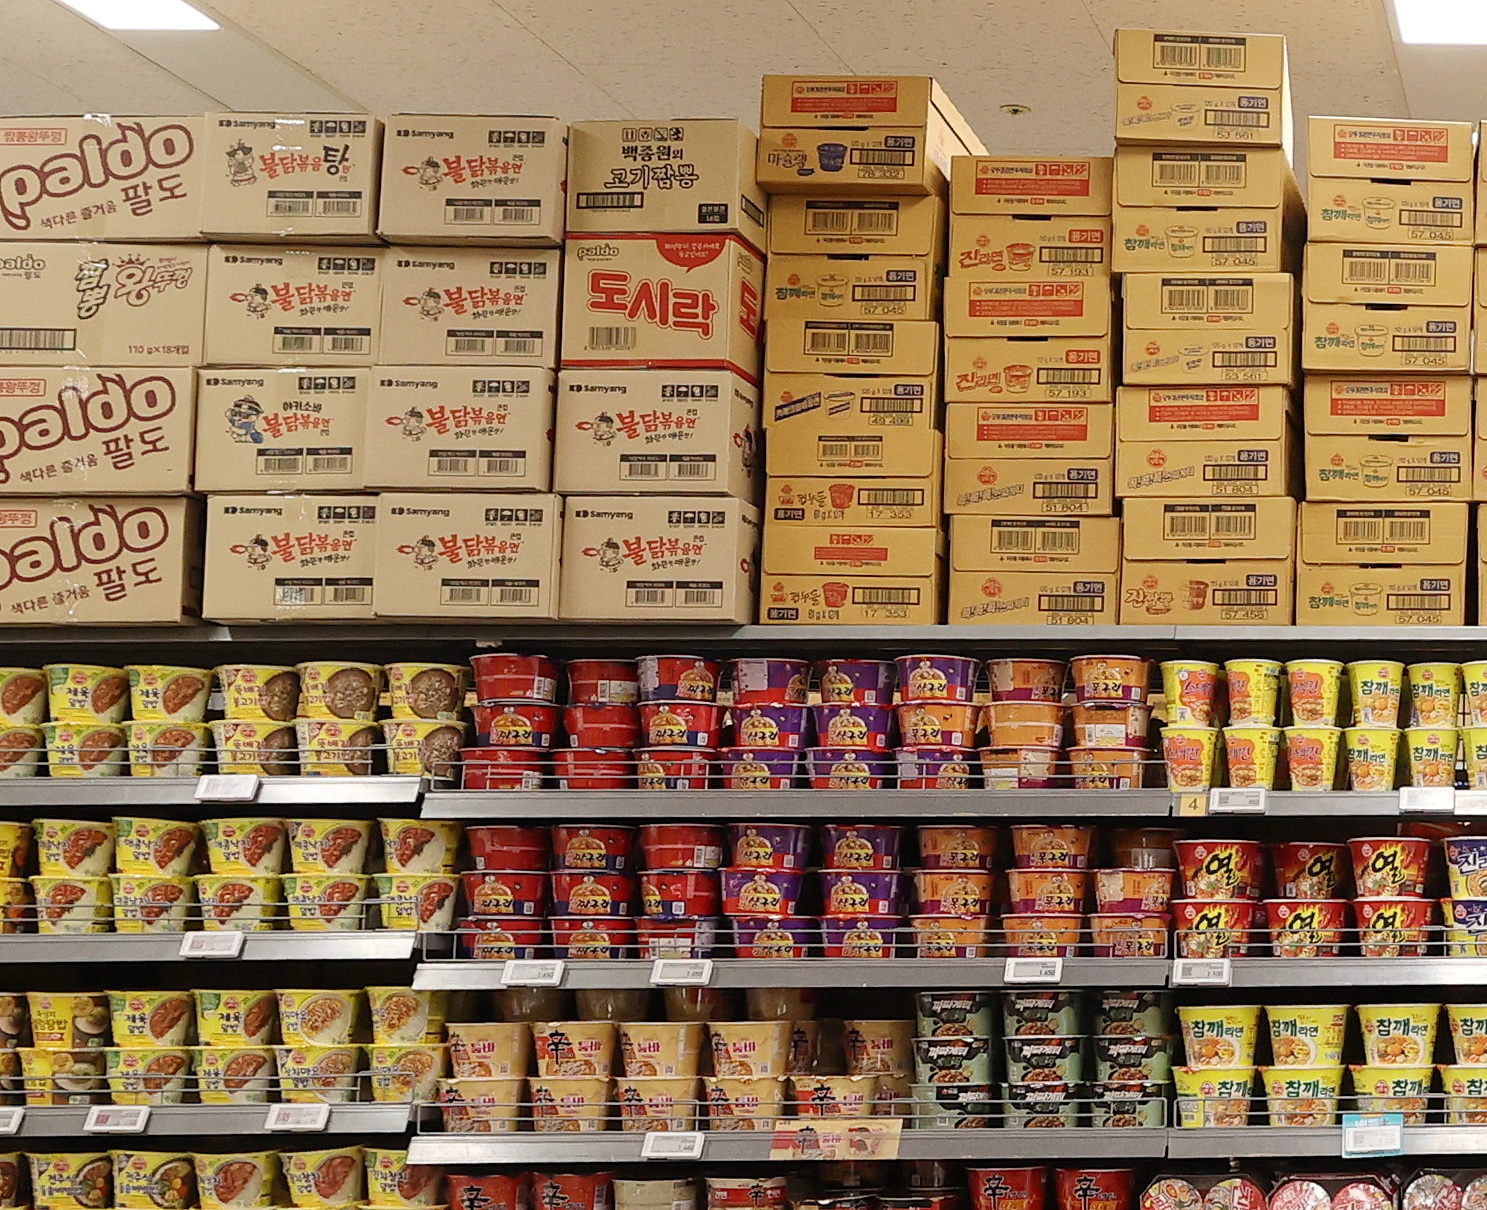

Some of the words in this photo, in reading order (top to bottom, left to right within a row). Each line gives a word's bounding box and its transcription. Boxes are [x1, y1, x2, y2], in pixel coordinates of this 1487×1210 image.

[621, 144, 683, 162] 백종원의
[1, 122, 193, 230] paldo
[605, 164, 700, 189] 고기짬뽕
[577, 244, 620, 261] paldo
[588, 269, 719, 340] 도시락
[1187, 797, 1198, 812] 4
[1204, 852, 1238, 890] 열
[1371, 850, 1403, 888] 열
[1191, 1017, 1245, 1041] 참깨라면
[1376, 1015, 1430, 1040] 참깨라면
[984, 1176, 1009, 1210] 辛
